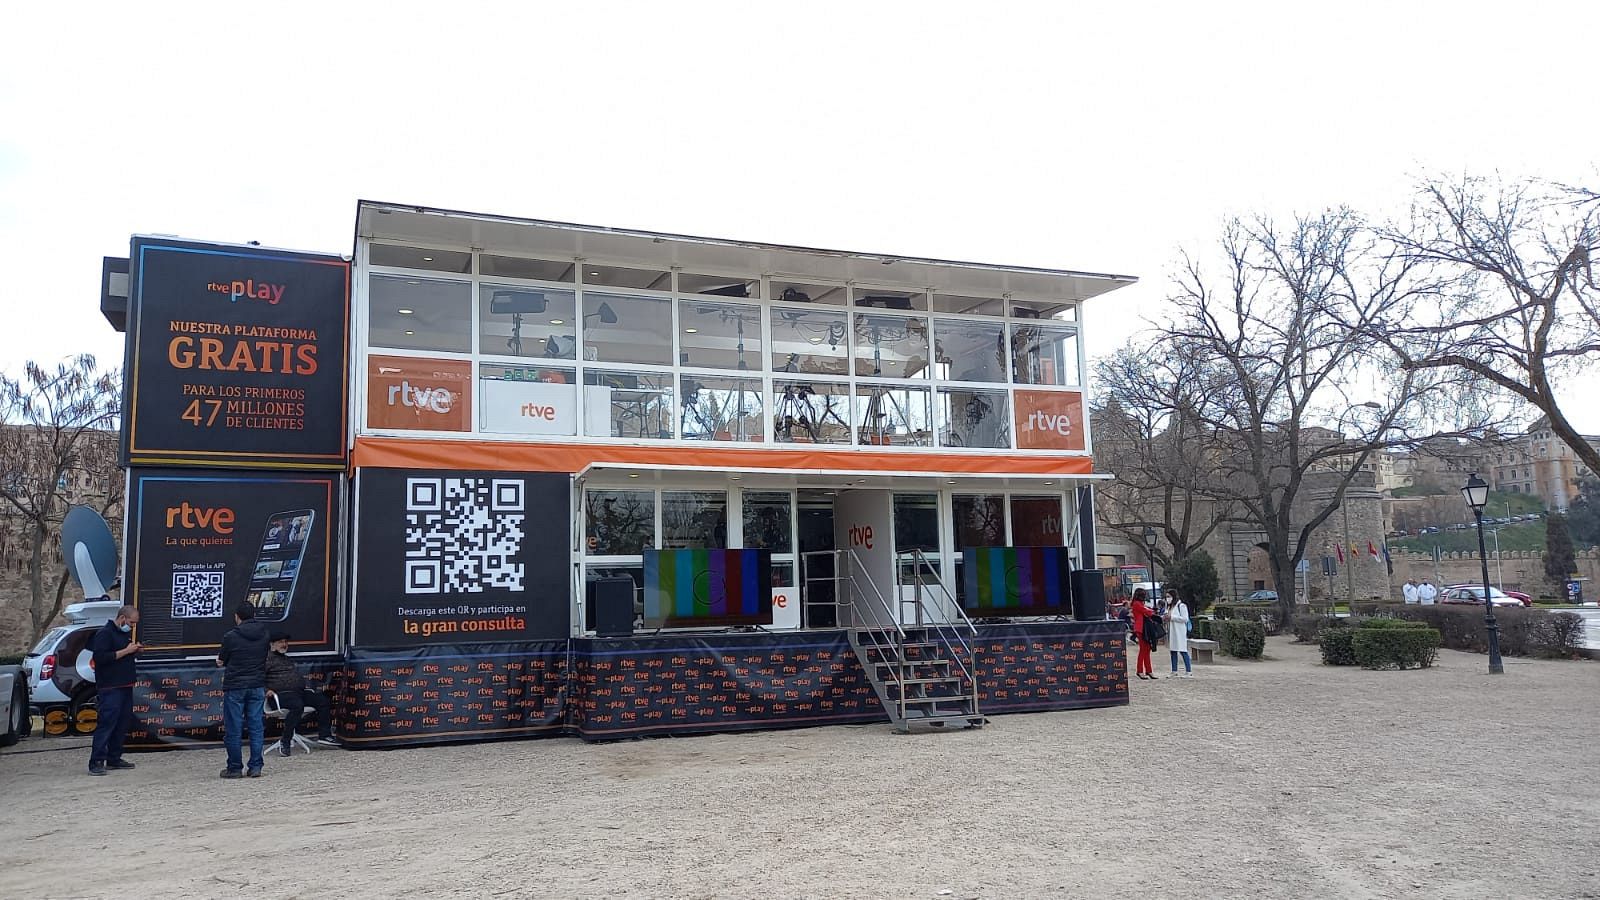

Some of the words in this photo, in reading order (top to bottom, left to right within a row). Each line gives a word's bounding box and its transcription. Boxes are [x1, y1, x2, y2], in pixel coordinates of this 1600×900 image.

[170, 321, 230, 335] NUESTRA
[235, 326, 317, 340] PLATAFORMA
[168, 336, 318, 375] GRATIS
[183, 384, 216, 396] PARA
[219, 386, 241, 396] LOS
[245, 387, 304, 400] PRIMEROS
[388, 379, 452, 414] rtve
[181, 399, 222, 427] 47
[226, 401, 304, 416] MILLONES
[521, 402, 555, 421] rtve
[226, 417, 242, 428] DE
[246, 418, 304, 430] CLIENTES
[1027, 409, 1071, 435] rtve
[166, 501, 234, 534] rtve
[1042, 513, 1061, 534] rtv
[166, 536, 177, 545] La
[180, 538, 197, 546] que
[200, 537, 233, 547] quieres
[849, 524, 873, 549] rtve
[398, 607, 436, 616] Descarga
[458, 606, 469, 614] QR
[470, 608, 476, 616] y
[478, 605, 513, 615] participa
[404, 620, 418, 634] la
[422, 621, 458, 636] gran
[461, 617, 525, 632] consulta
